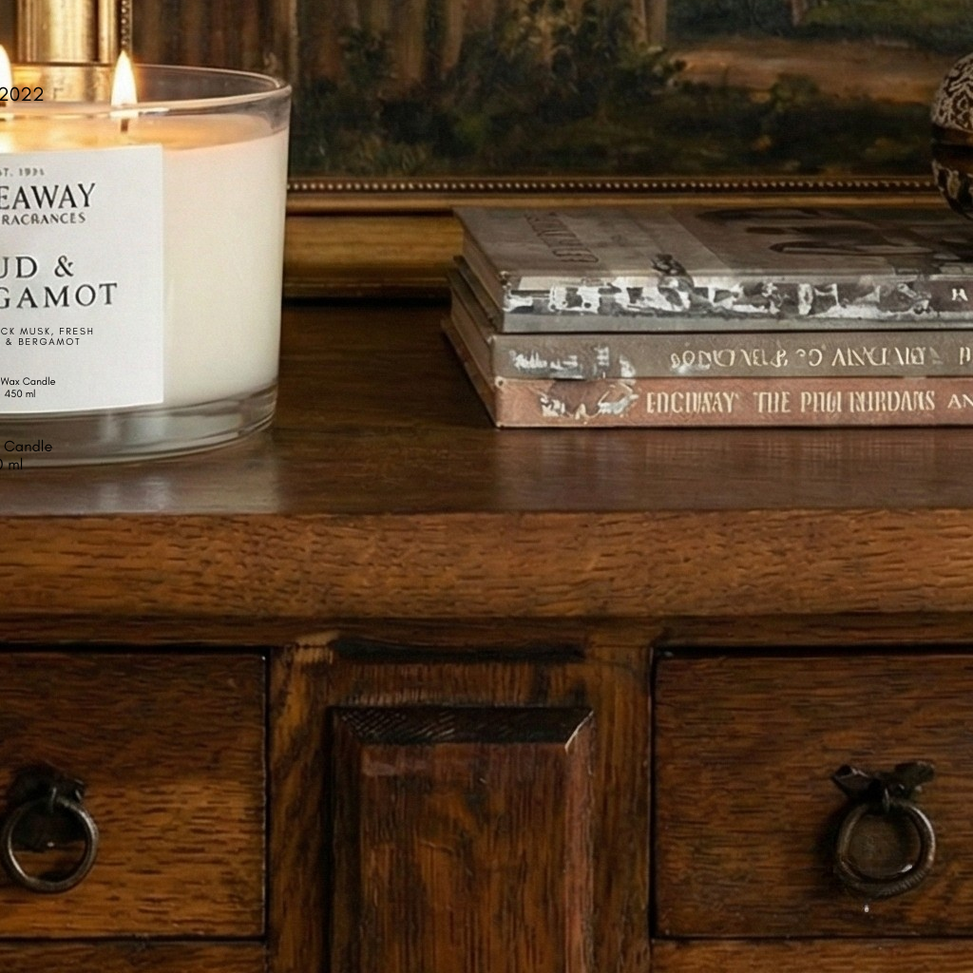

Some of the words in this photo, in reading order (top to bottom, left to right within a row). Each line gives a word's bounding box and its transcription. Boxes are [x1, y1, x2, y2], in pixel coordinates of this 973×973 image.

[54, 255, 74, 277] &
[20, 327, 54, 336] MUSK,
[60, 327, 93, 336] FRESH
[6, 338, 12, 346] &
[18, 338, 80, 346] BERGAMOT
[0, 377, 20, 386] Wax
[22, 376, 55, 386] Candle
[4, 389, 23, 398] 450
[26, 389, 35, 398] ml
